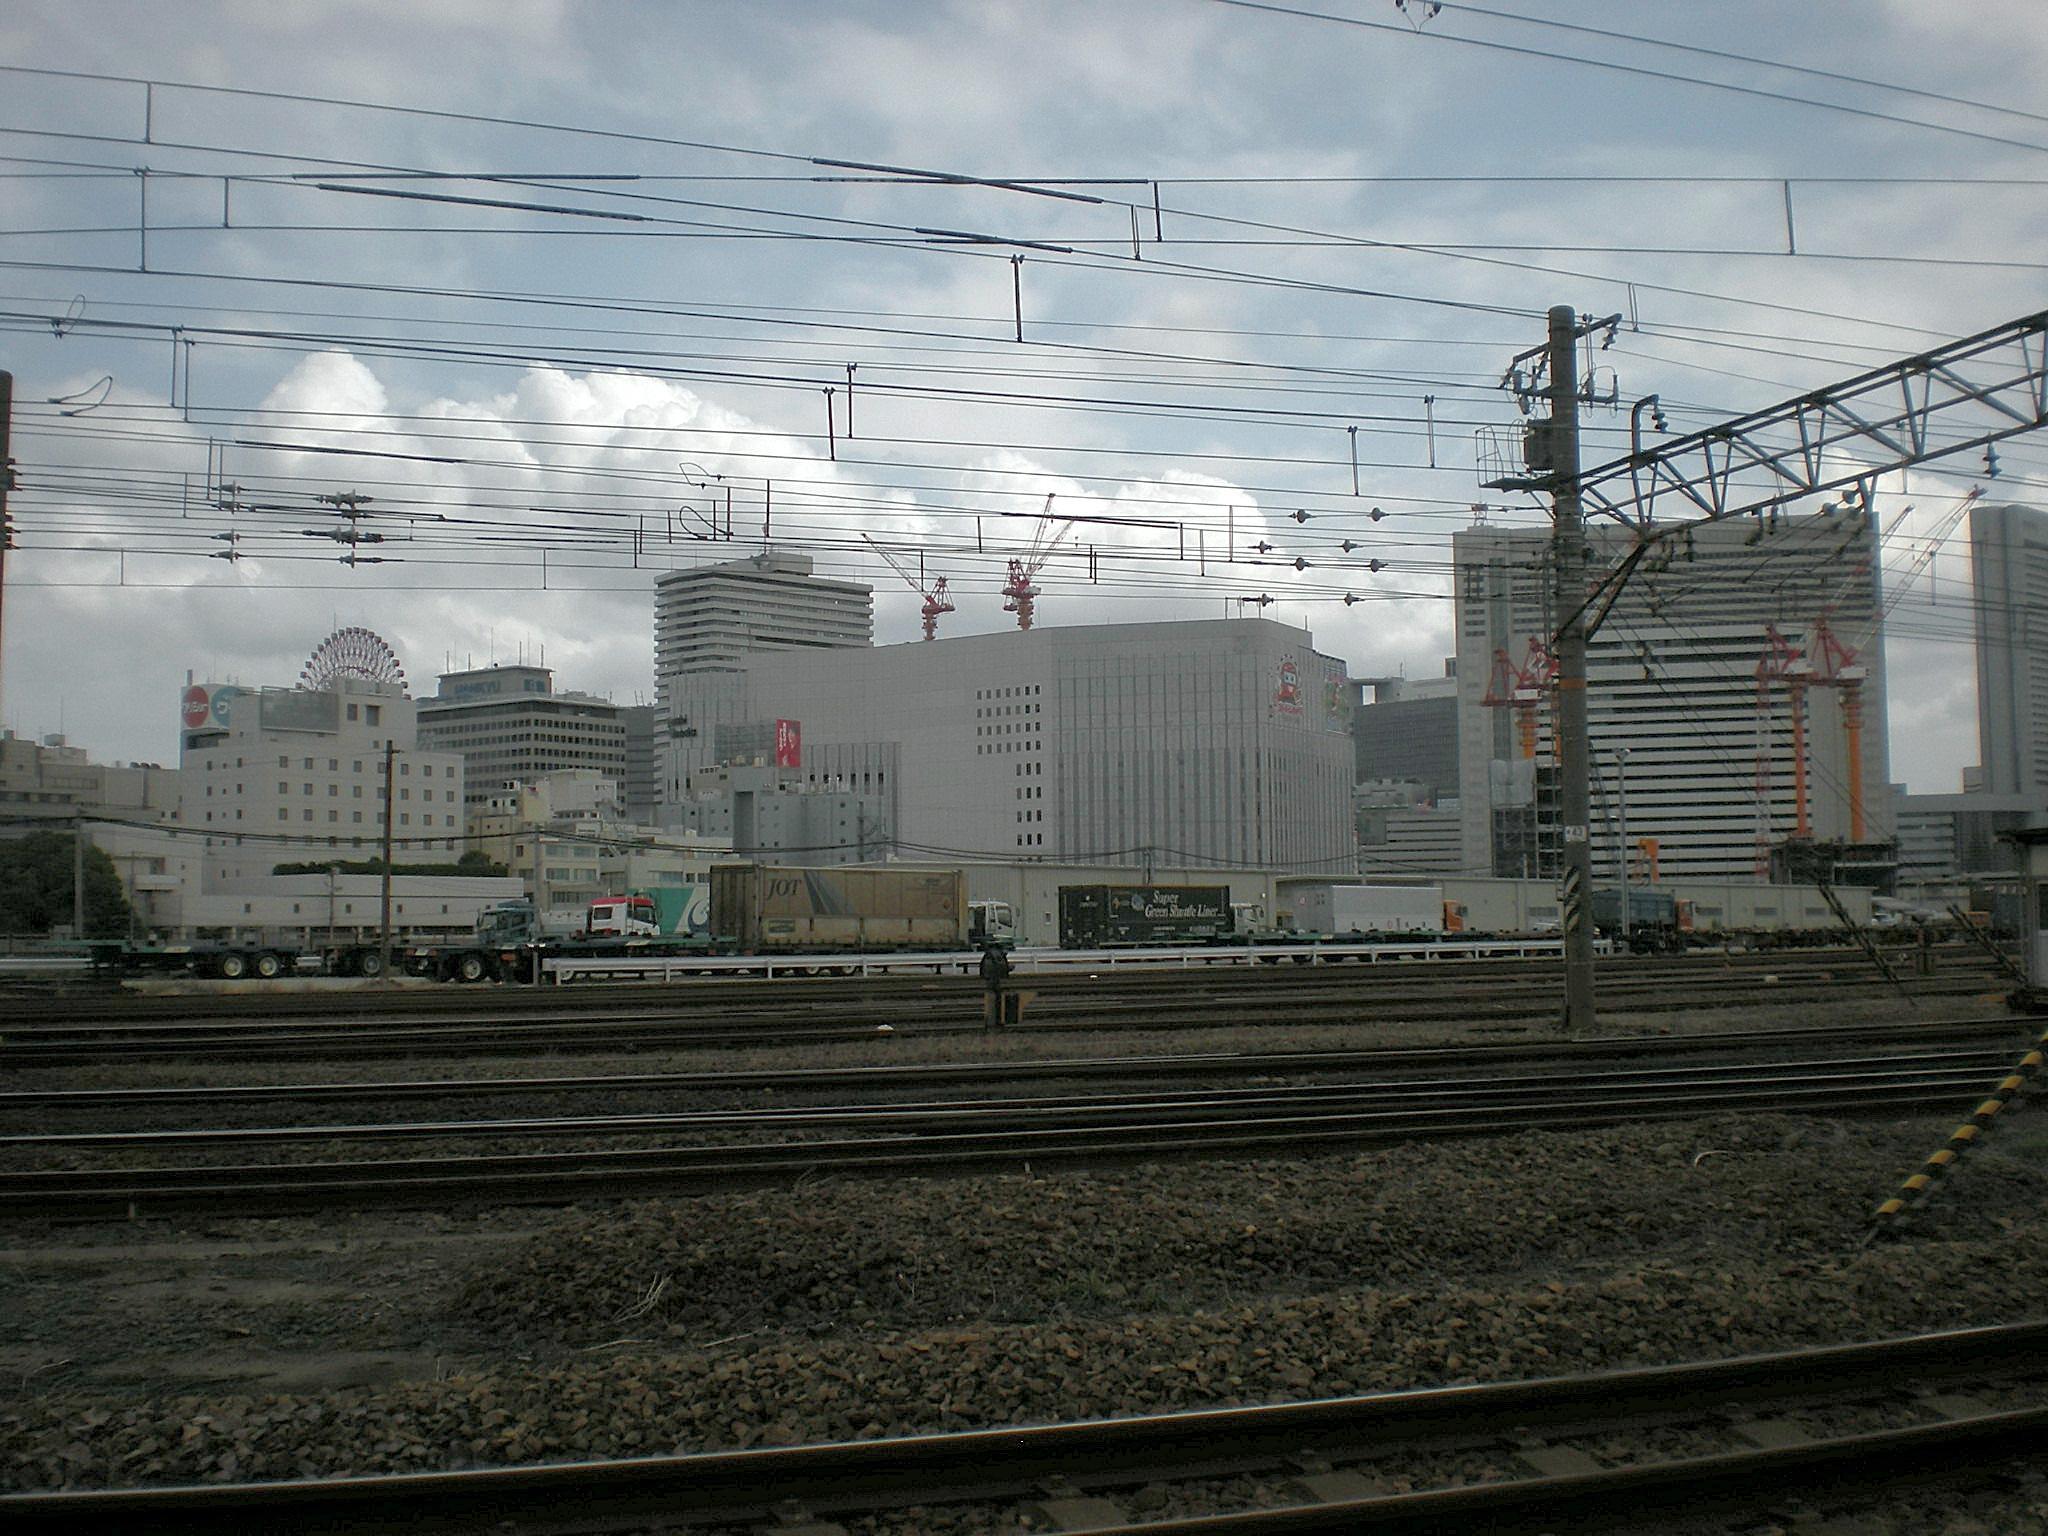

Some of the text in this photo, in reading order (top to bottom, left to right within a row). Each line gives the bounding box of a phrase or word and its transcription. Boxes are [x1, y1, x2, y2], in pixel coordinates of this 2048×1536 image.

[767, 880, 801, 900] JOT
[1153, 890, 1179, 904] Super
[1145, 904, 1218, 918] Green Shuttle Liner
